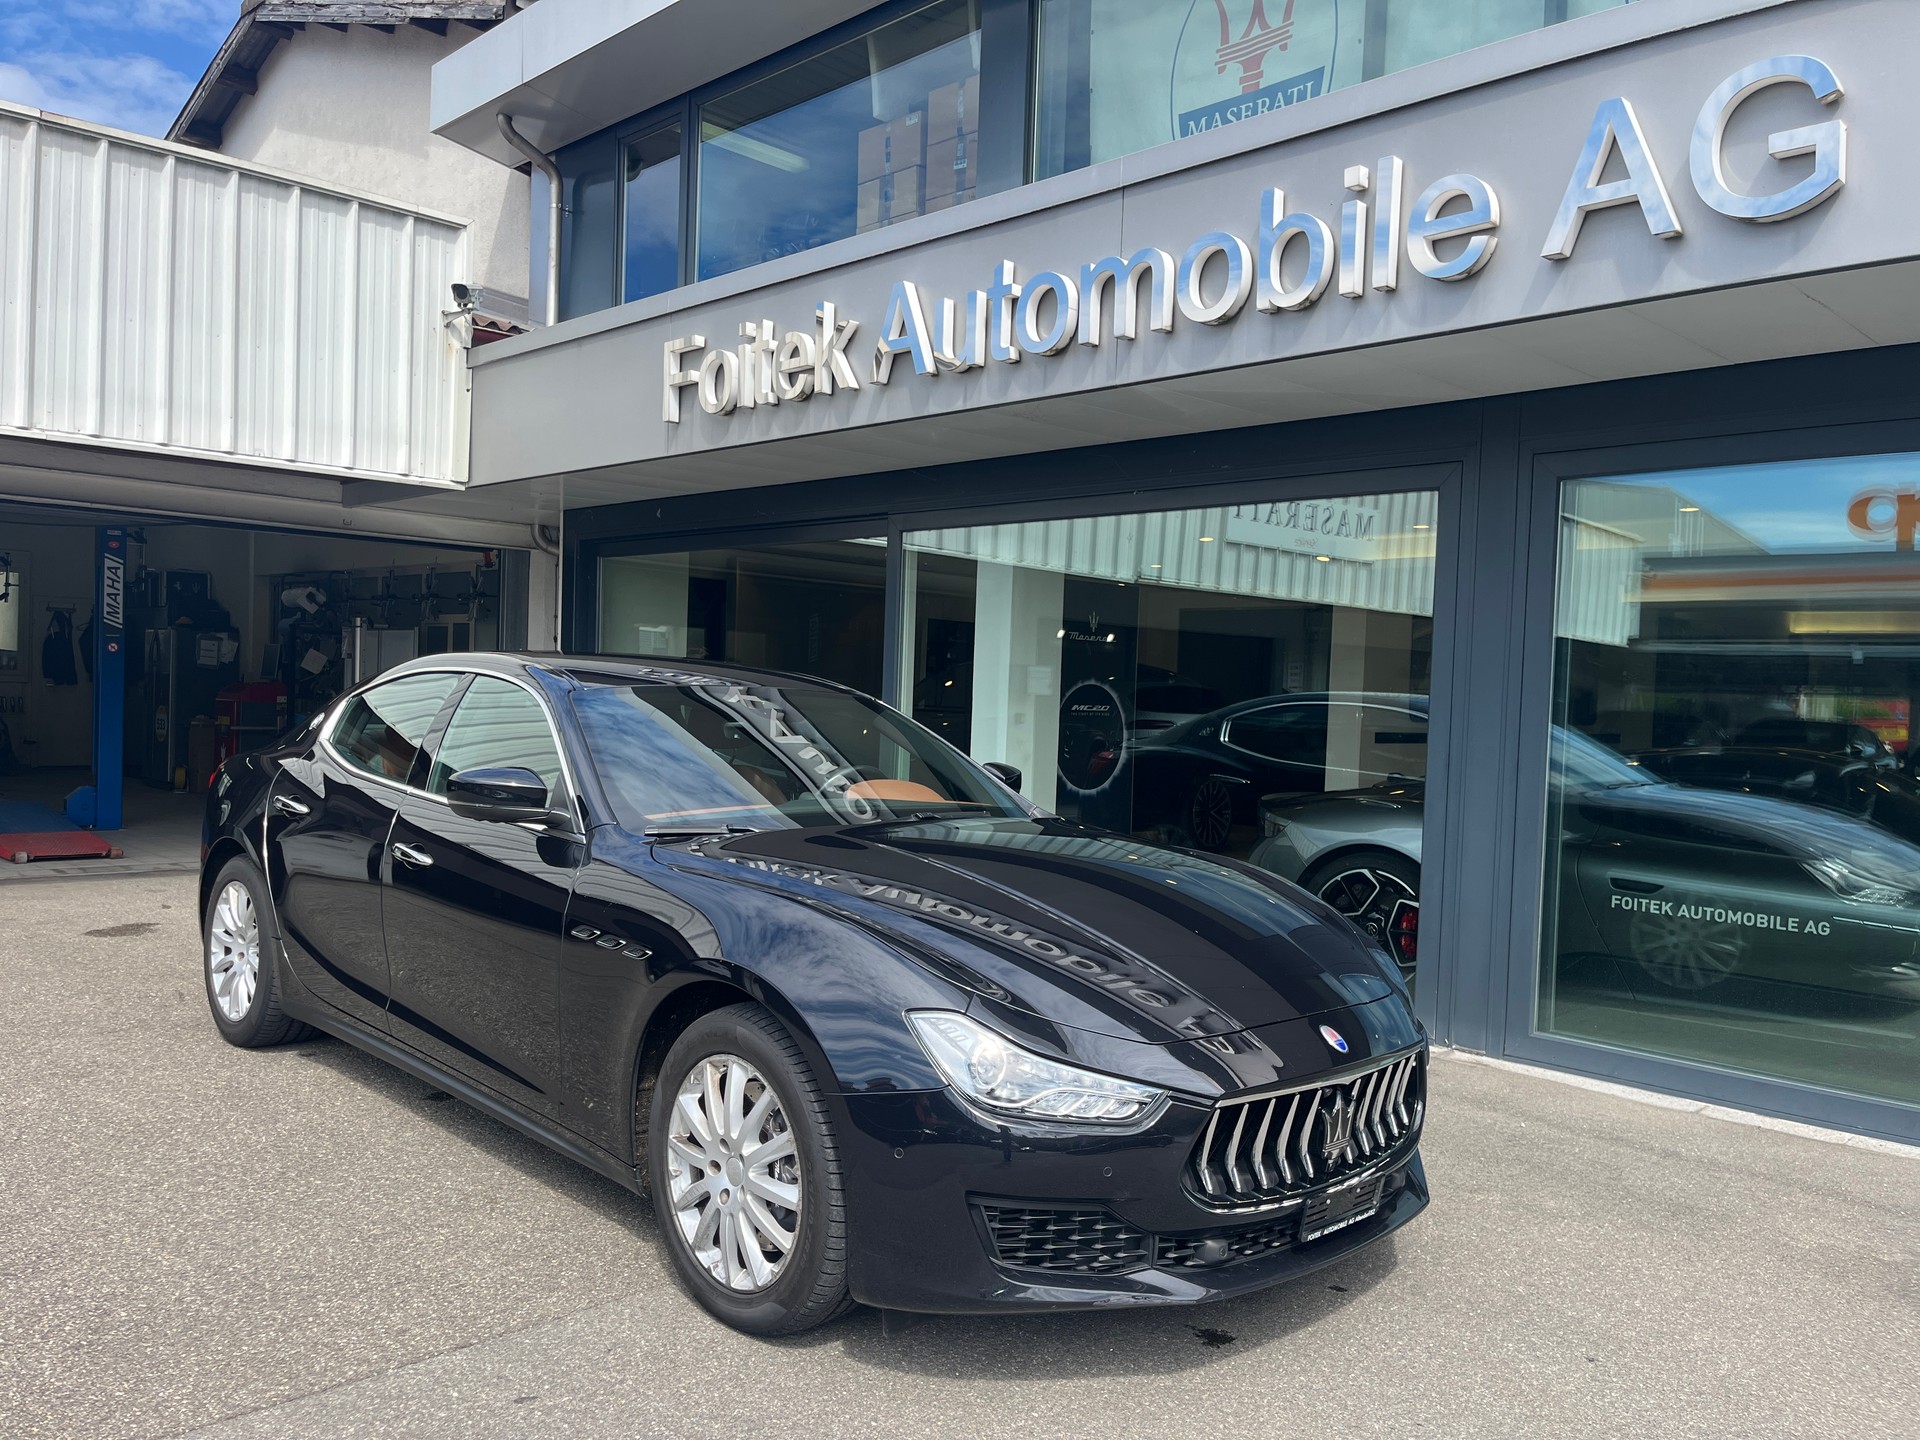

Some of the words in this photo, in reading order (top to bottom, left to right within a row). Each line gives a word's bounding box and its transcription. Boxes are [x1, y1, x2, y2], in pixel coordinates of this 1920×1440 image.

[1187, 80, 1315, 136] MASERATI
[662, 301, 860, 423] Foitek
[868, 156, 1501, 385] Automobile
[1540, 54, 1848, 261] AG
[106, 566, 121, 620] MAHA
[1068, 631, 1116, 642] Masera
[1611, 895, 1674, 916] FOITEK
[1677, 904, 1800, 933] AUTOMOBILE
[1804, 919, 1831, 937] AG
